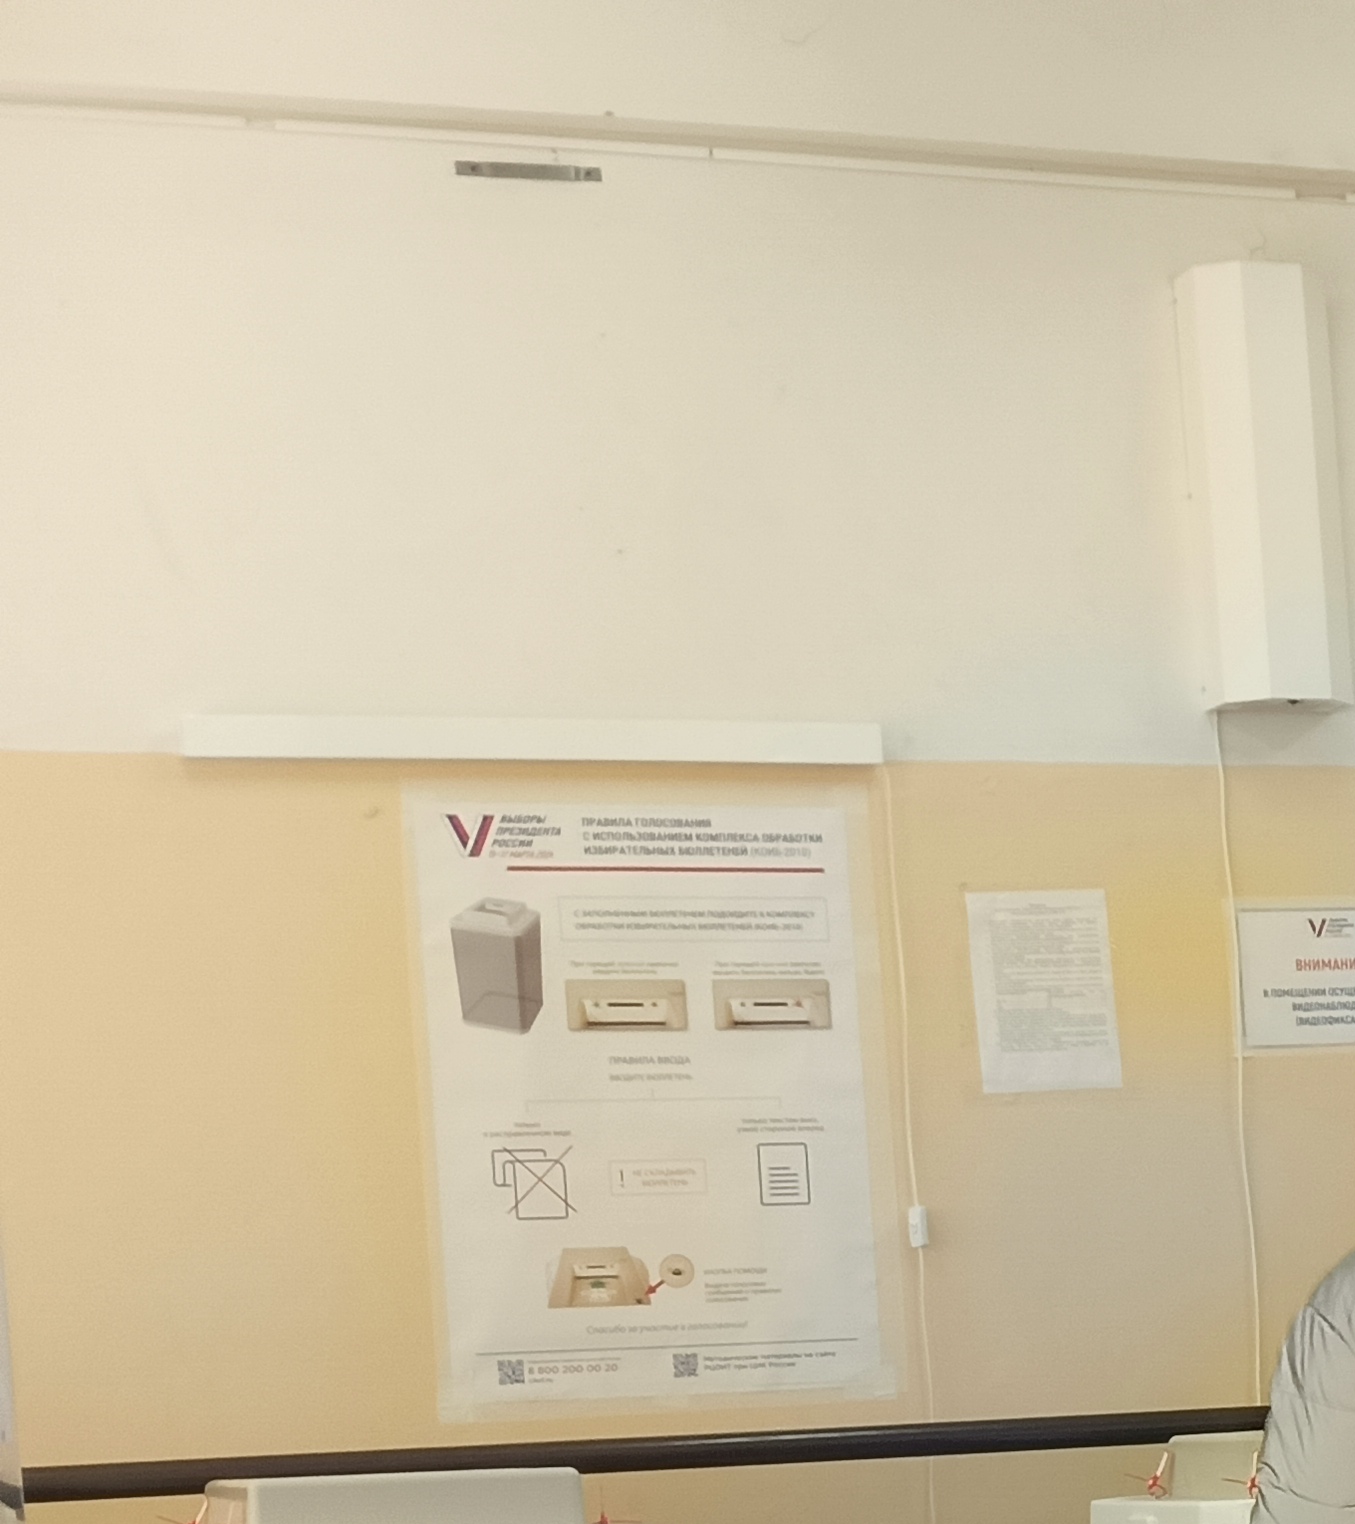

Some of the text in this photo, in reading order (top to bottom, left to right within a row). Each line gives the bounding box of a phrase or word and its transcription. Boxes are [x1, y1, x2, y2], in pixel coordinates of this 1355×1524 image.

[499, 814, 547, 824] ВЫБОРЫ
[581, 816, 711, 829] ПРАВИЛА ГОЛОСОВАНИЯ
[495, 826, 562, 837] ПРЕЗИДЕНТА
[491, 838, 534, 848] РОССИИ
[592, 832, 693, 843] ИСПОЛЬЗОВАНИЕМ
[695, 832, 759, 843] КОМПЛЕКСА
[761, 833, 823, 844] ОБРАБОТКИ
[584, 845, 676, 857] ИЗБИРАТЕЛЬНЫХ
[678, 845, 749, 857] БЮЛЛЕТЕНЕЙ
[1271, 987, 1327, 998] ПОМЕЩЕНИИ
[528, 1363, 619, 1375] 8 800 200 00 20
